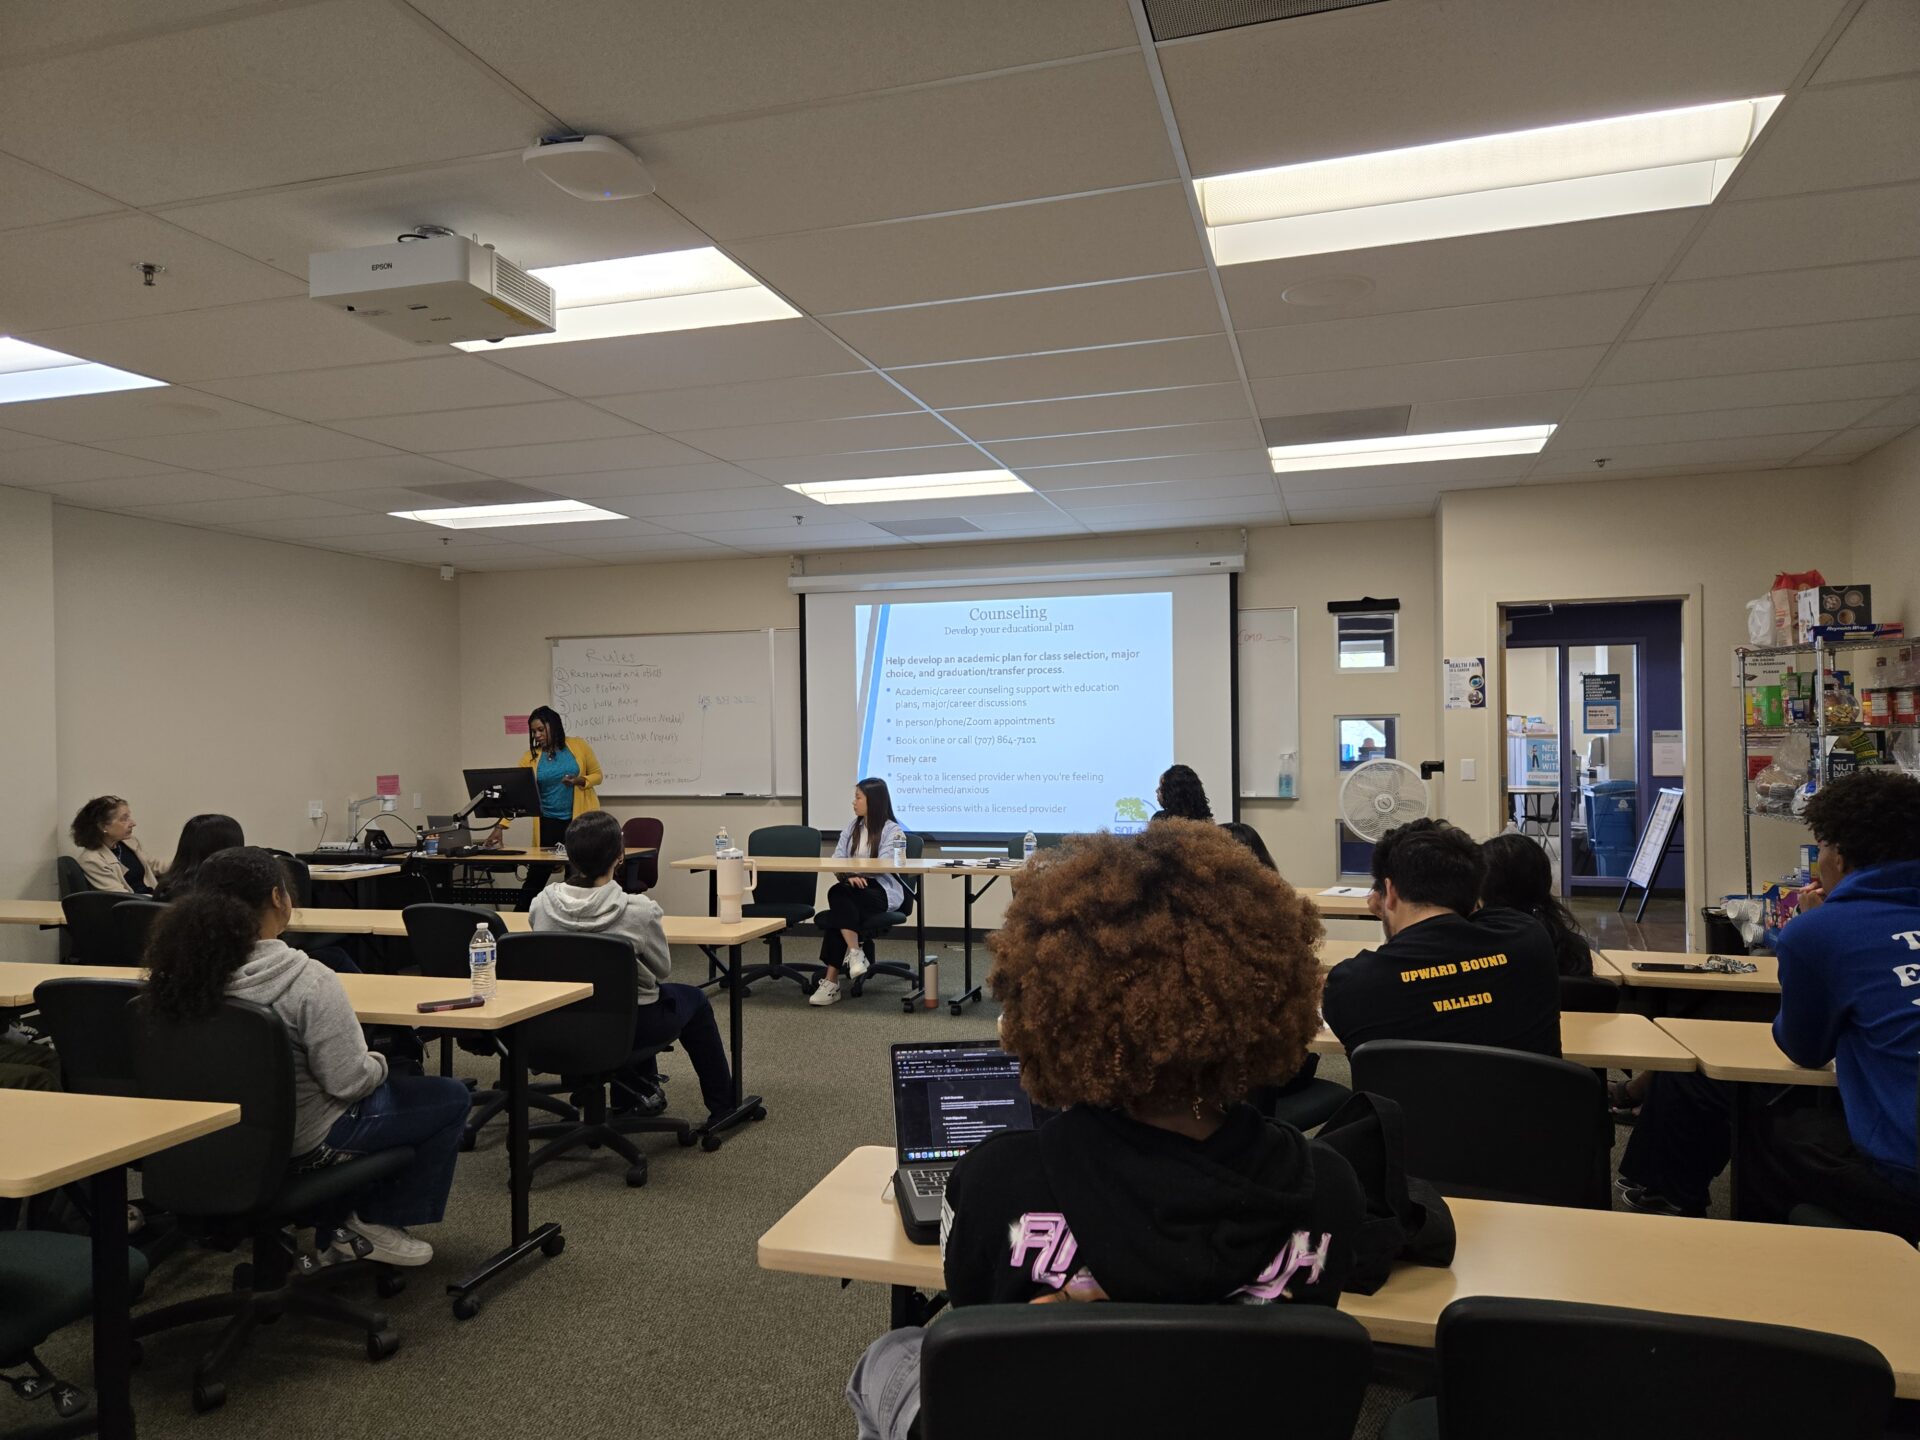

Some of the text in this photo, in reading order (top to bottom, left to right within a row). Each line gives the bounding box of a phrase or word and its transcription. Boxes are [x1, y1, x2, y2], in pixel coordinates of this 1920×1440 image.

[371, 262, 393, 271] EPSON
[969, 605, 1048, 622] Counseling
[944, 622, 1075, 637] Develop your educational plan
[585, 649, 636, 663] Rules
[885, 649, 1140, 667] Help develop an academic plan for class selection, major
[885, 665, 1065, 680] choice, and graduation/transfer process.
[895, 683, 1120, 697] Academic/career counseling support with education
[895, 698, 1027, 711] plans, major/career discussions
[895, 716, 1056, 729] In person/phone/Zoom appointments
[895, 735, 1037, 746] Book online or call (707) 864-7101
[886, 754, 917, 765] Timely
[1833, 763, 1856, 771] NUT
[896, 772, 925, 783] Speak
[925, 773, 935, 781] to
[941, 772, 977, 782] licensed
[978, 772, 1015, 783] provider
[1016, 772, 1041, 781] when
[1042, 772, 1071, 783] you're
[1072, 771, 1104, 783] feeling
[896, 785, 990, 795] overwhelmed/anxious
[896, 804, 908, 812] 12
[908, 802, 925, 812] free
[926, 803, 962, 813] sessions
[963, 802, 983, 813] with
[991, 802, 1028, 814] licensed
[1028, 804, 1068, 815] provider
[1400, 953, 1508, 983] UPWARD BOUND
[1432, 991, 1493, 1013] VALLEJO
